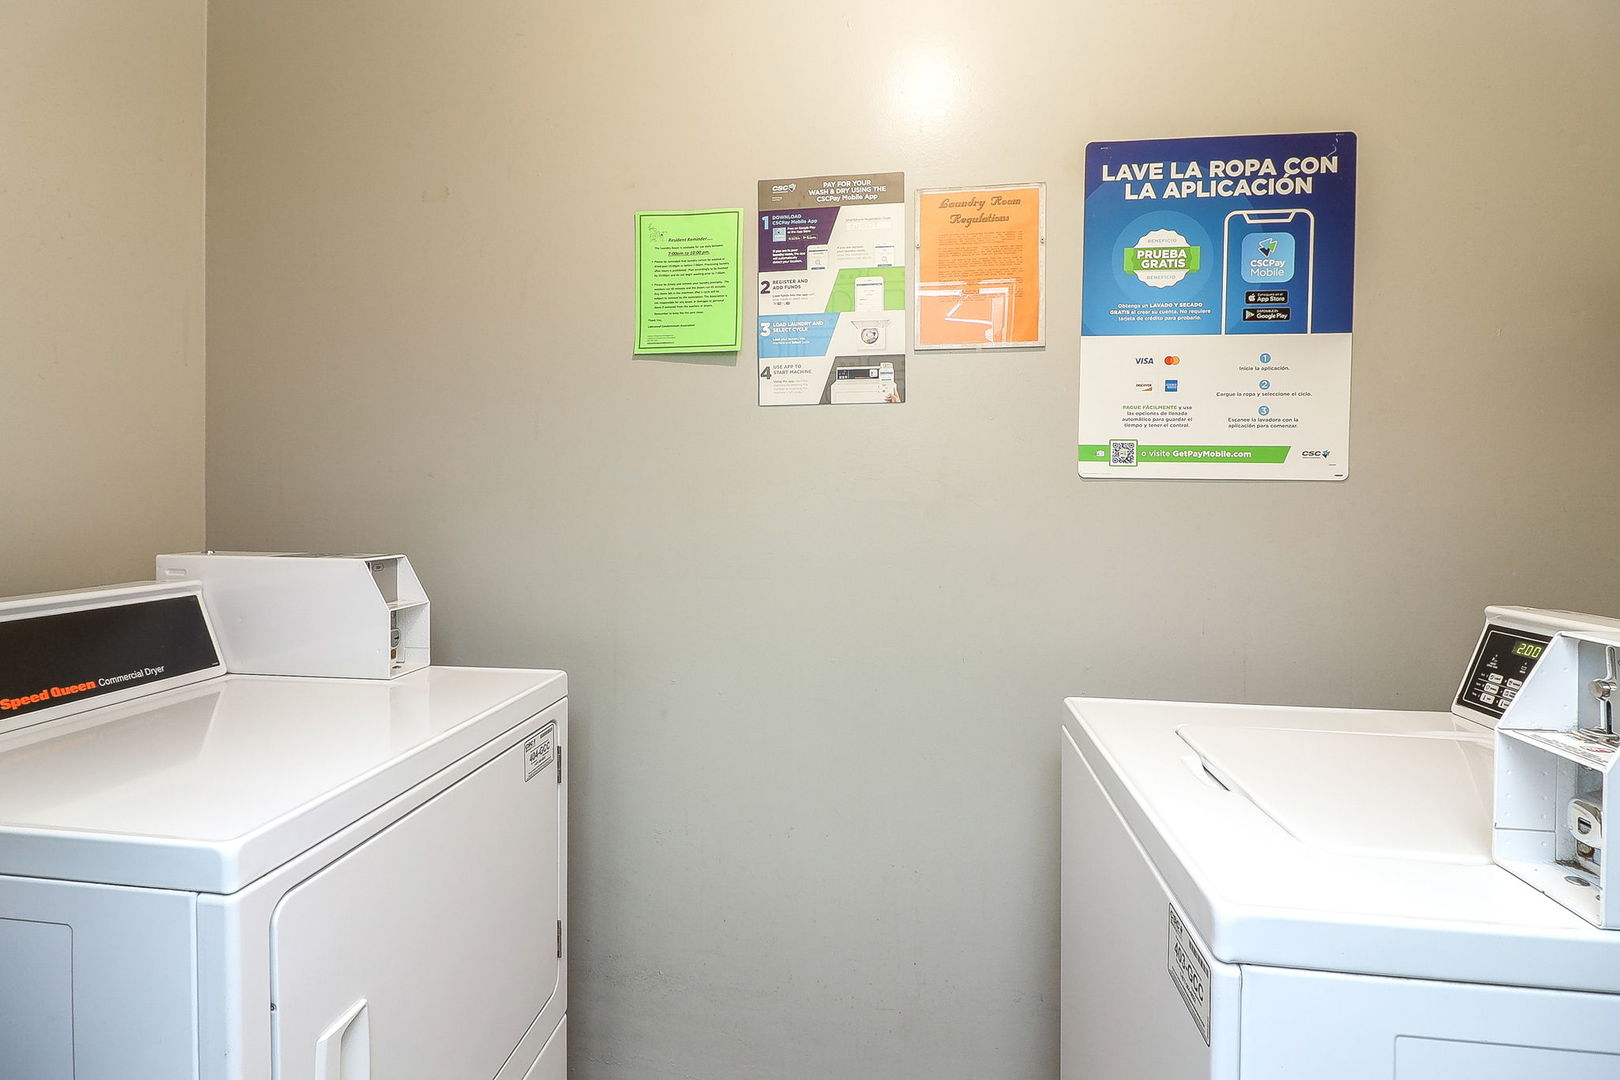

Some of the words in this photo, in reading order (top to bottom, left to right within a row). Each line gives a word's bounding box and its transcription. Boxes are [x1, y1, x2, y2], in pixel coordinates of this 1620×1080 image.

[1102, 162, 1164, 182] LAVE
[1171, 162, 1202, 179] LA
[1210, 158, 1277, 178] ROPA
[1284, 156, 1338, 174] CON
[1125, 183, 1157, 200] LA
[1162, 174, 1313, 199] APLICACIÓN
[939, 197, 986, 211] Laundry
[991, 196, 1021, 206] Room
[762, 216, 769, 230] 1
[950, 213, 1010, 228] Regulations
[1137, 249, 1187, 259] PRUEBA
[1141, 259, 1186, 268] GRATIS
[1250, 260, 1285, 268] CSCPay
[1251, 268, 1284, 277] Mobile
[761, 280, 770, 294] 2
[761, 322, 770, 337] 3
[761, 367, 771, 380] 4
[1261, 381, 1267, 389] 2
[1173, 450, 1252, 458] GetPayMobile.com
[1517, 643, 1542, 658] 2.00
[0, 690, 50, 710] Speed
[50, 681, 96, 698] Queen
[98, 670, 144, 687] Commercial
[145, 665, 165, 677] Dryer
